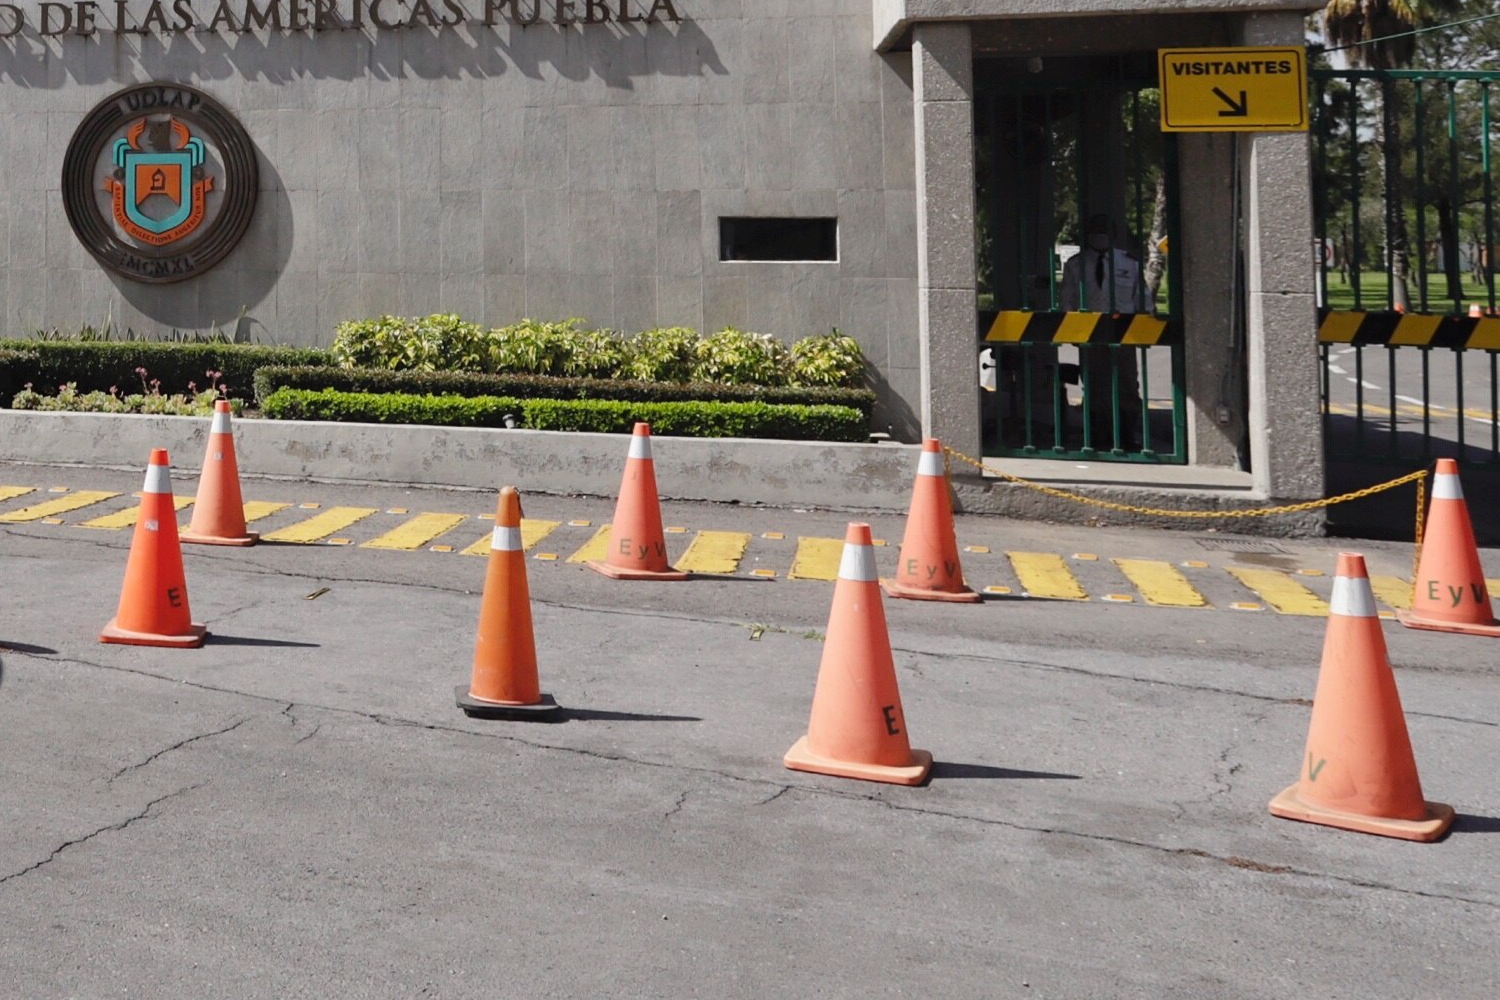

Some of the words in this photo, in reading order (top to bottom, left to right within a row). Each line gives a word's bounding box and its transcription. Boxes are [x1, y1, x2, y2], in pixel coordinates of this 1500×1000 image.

[38, 1, 97, 36] DE
[1172, 60, 1291, 76] VISITANTES
[167, 587, 182, 608] E
[882, 705, 900, 736] E
[1308, 751, 1327, 782] V
